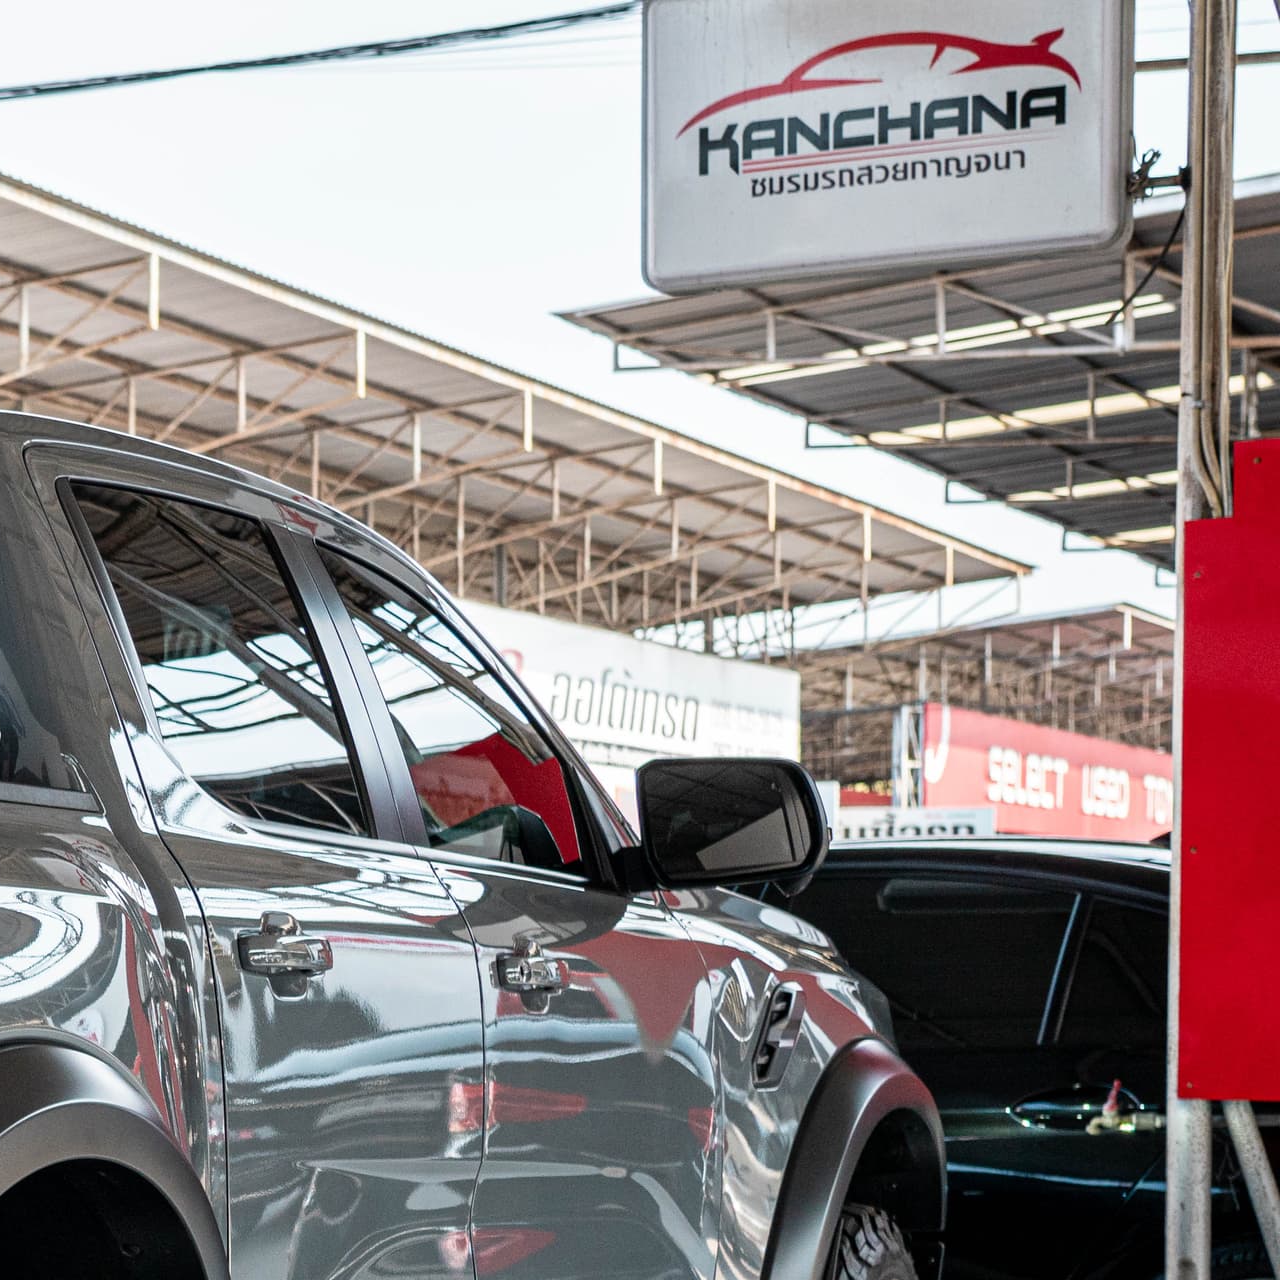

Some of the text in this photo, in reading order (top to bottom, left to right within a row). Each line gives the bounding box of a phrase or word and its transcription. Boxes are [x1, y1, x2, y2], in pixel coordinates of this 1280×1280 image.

[697, 84, 1067, 177] KANCHANA
[750, 148, 1027, 198] ชมรมรถสวยกาญจนา
[988, 747, 1068, 809] SELECT
[1082, 765, 1130, 819] USED
